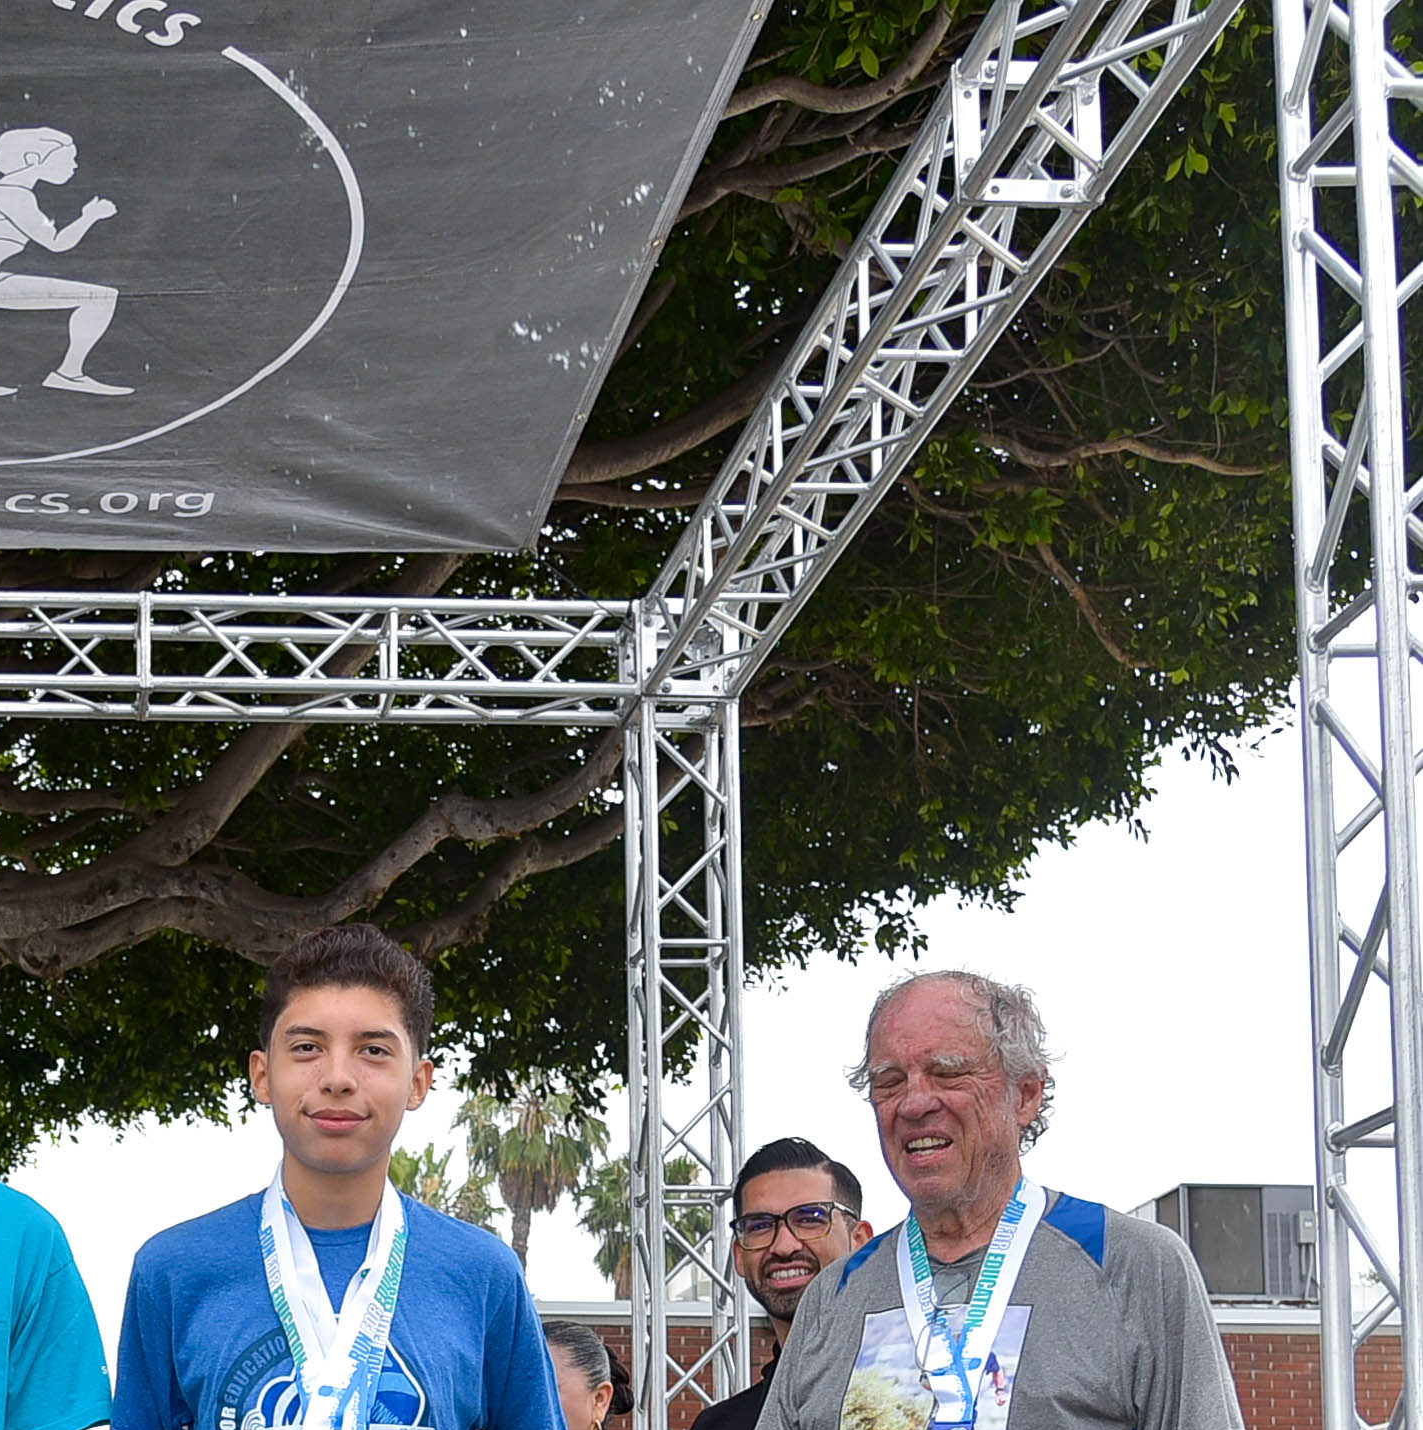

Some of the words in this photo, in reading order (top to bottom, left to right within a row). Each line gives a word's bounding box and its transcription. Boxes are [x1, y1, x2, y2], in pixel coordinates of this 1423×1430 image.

[990, 1221, 1018, 1252] FOR
[1000, 1200, 1028, 1225] RUN
[260, 1225, 276, 1257] RUN
[272, 1283, 308, 1366] EDUCATION
[965, 1252, 1007, 1328] EDUCATION
[348, 1331, 373, 1364] RUN
[361, 1302, 385, 1338] FOR
[224, 1335, 287, 1405] EDUCATIO
